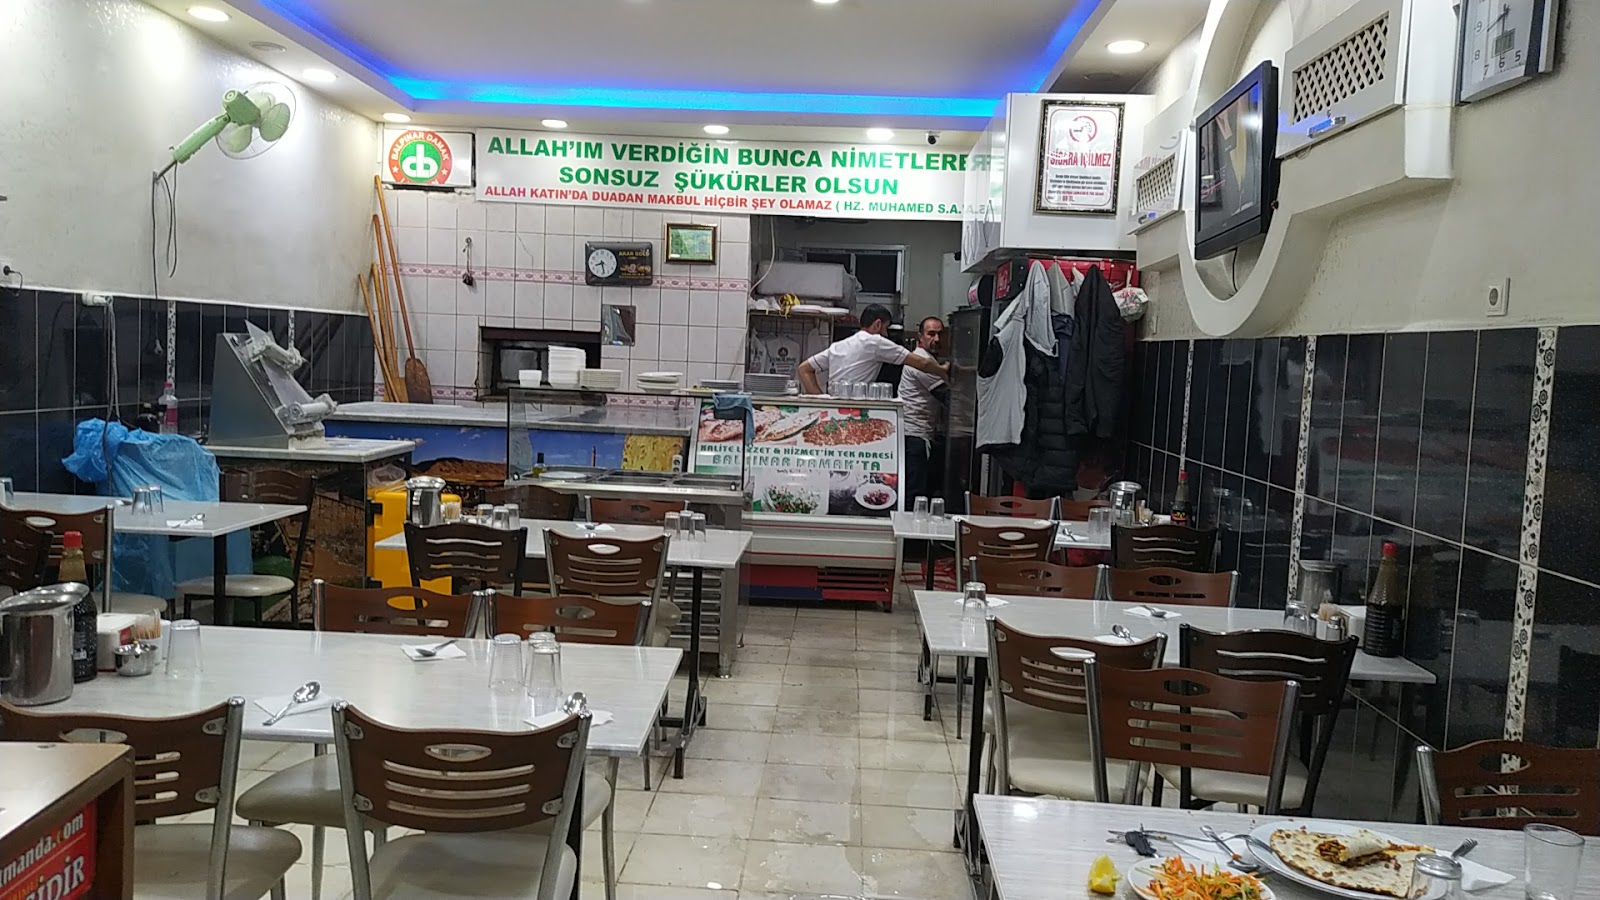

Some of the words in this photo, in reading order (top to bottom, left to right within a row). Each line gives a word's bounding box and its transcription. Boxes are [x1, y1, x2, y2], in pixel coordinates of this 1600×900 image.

[1476, 21, 1482, 33] 9
[1474, 49, 1480, 61] 8
[1498, 57, 1505, 69] 6
[1514, 49, 1521, 62] 5
[1483, 64, 1489, 76] 7
[426, 133, 449, 161] DAMAK
[487, 136, 603, 160] ALLAH'IM
[611, 141, 728, 165] VERDİĞİN
[738, 147, 822, 168] BUNCA
[559, 166, 659, 188] SONSUZ
[674, 169, 807, 193] ŞÜKÜRLER
[815, 176, 898, 195] OLSUN
[485, 185, 526, 197] ALLAH
[530, 187, 588, 201] KATIN'DA
[592, 191, 643, 204] DUADAN
[648, 194, 700, 206] MAKBUL
[704, 194, 748, 208] HİÇBİR
[751, 198, 776, 210] ŞEY
[780, 199, 832, 210] OLAMAZ
[868, 202, 934, 214] MUHAMED
[858, 451, 894, 459] ADRESİ
[0, 812, 83, 888] manda.com
[25, 854, 84, 900] İDİR
